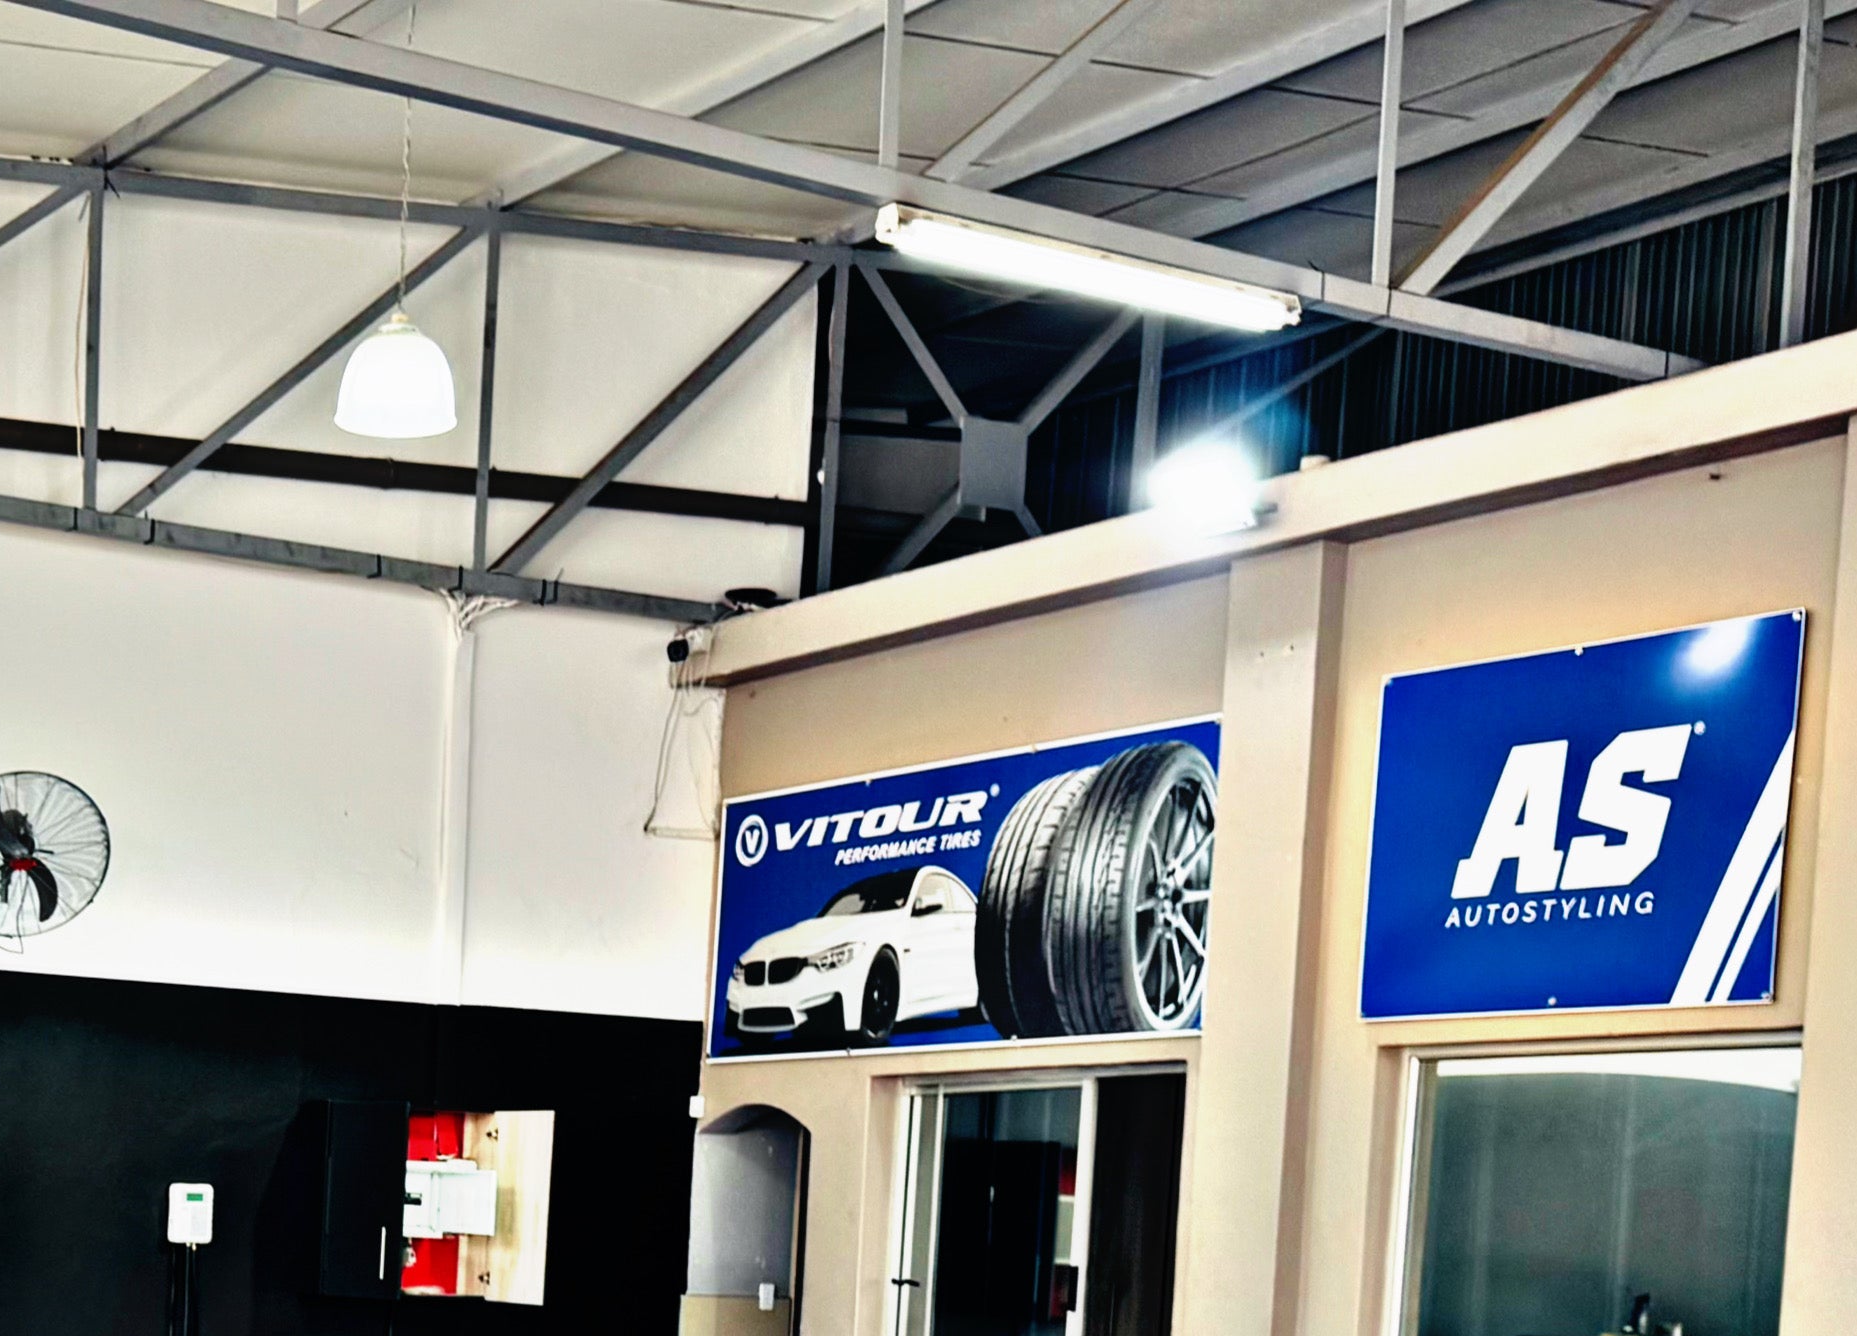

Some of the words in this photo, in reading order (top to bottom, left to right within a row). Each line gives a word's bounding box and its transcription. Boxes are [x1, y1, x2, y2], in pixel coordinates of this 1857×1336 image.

[775, 790, 989, 852] VITOUR
[1451, 723, 1692, 899] AS
[834, 836, 937, 866] PERFORMANCE
[939, 829, 982, 851] TIRES
[1444, 891, 1655, 929] AUTOSTYLING
